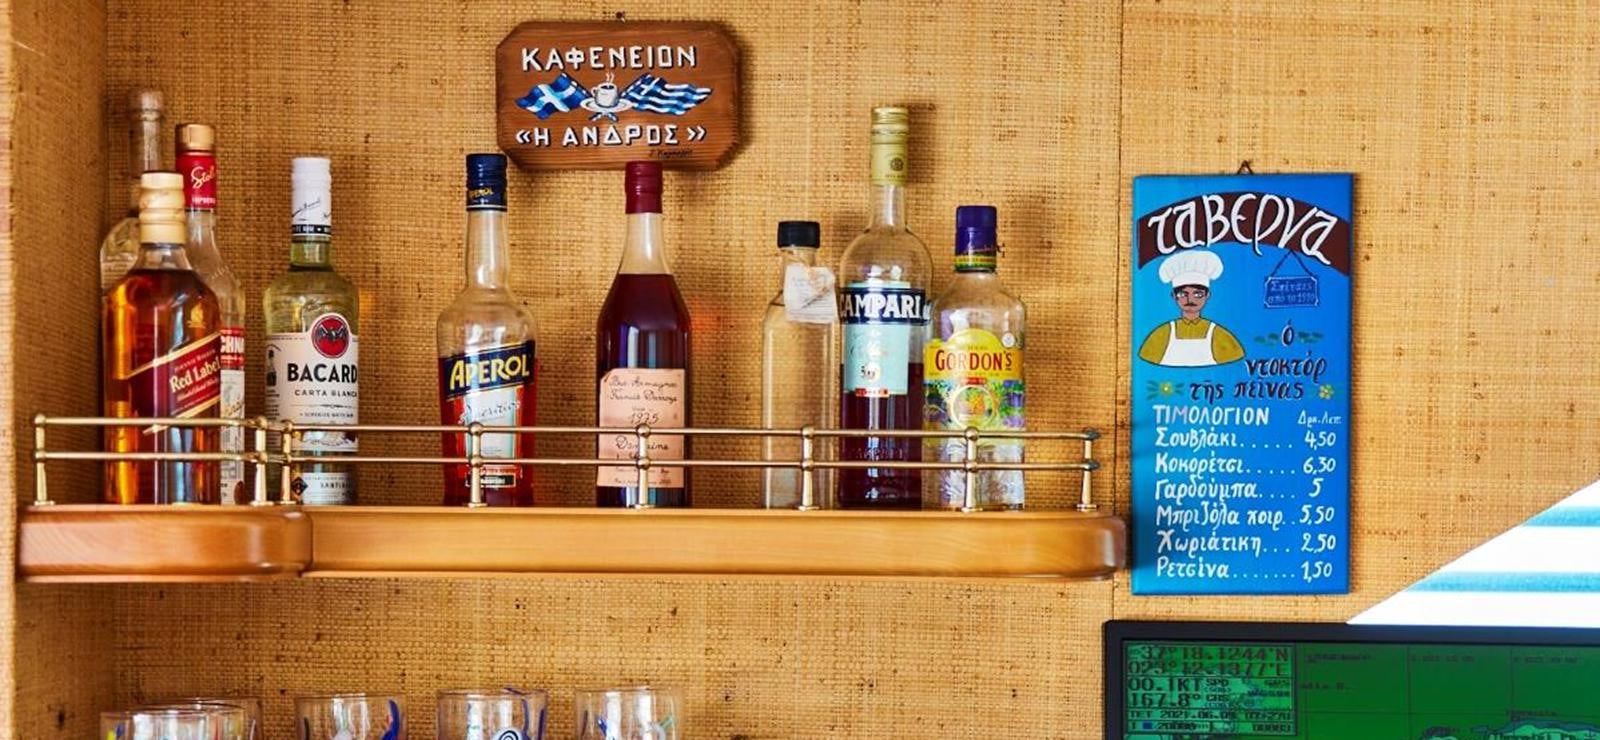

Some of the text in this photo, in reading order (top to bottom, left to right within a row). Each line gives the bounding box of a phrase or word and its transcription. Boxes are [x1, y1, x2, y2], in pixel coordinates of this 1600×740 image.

[521, 45, 697, 72] ΚΑΦΕΝΕΙΟΝ
[170, 369, 193, 392] Red
[192, 356, 221, 381] Label
[450, 354, 530, 391] APEROL
[294, 388, 328, 397] CARTA
[1152, 405, 1270, 426] ΤΙΜΟΛΟΓΙΟΝ
[1304, 430, 1336, 451] 4,50
[1303, 456, 1336, 475] 6,30
[1308, 477, 1324, 498] 5
[1299, 504, 1335, 525] 5,50
[1301, 532, 1336, 554] 2,50
[1301, 561, 1333, 583] 1,50
